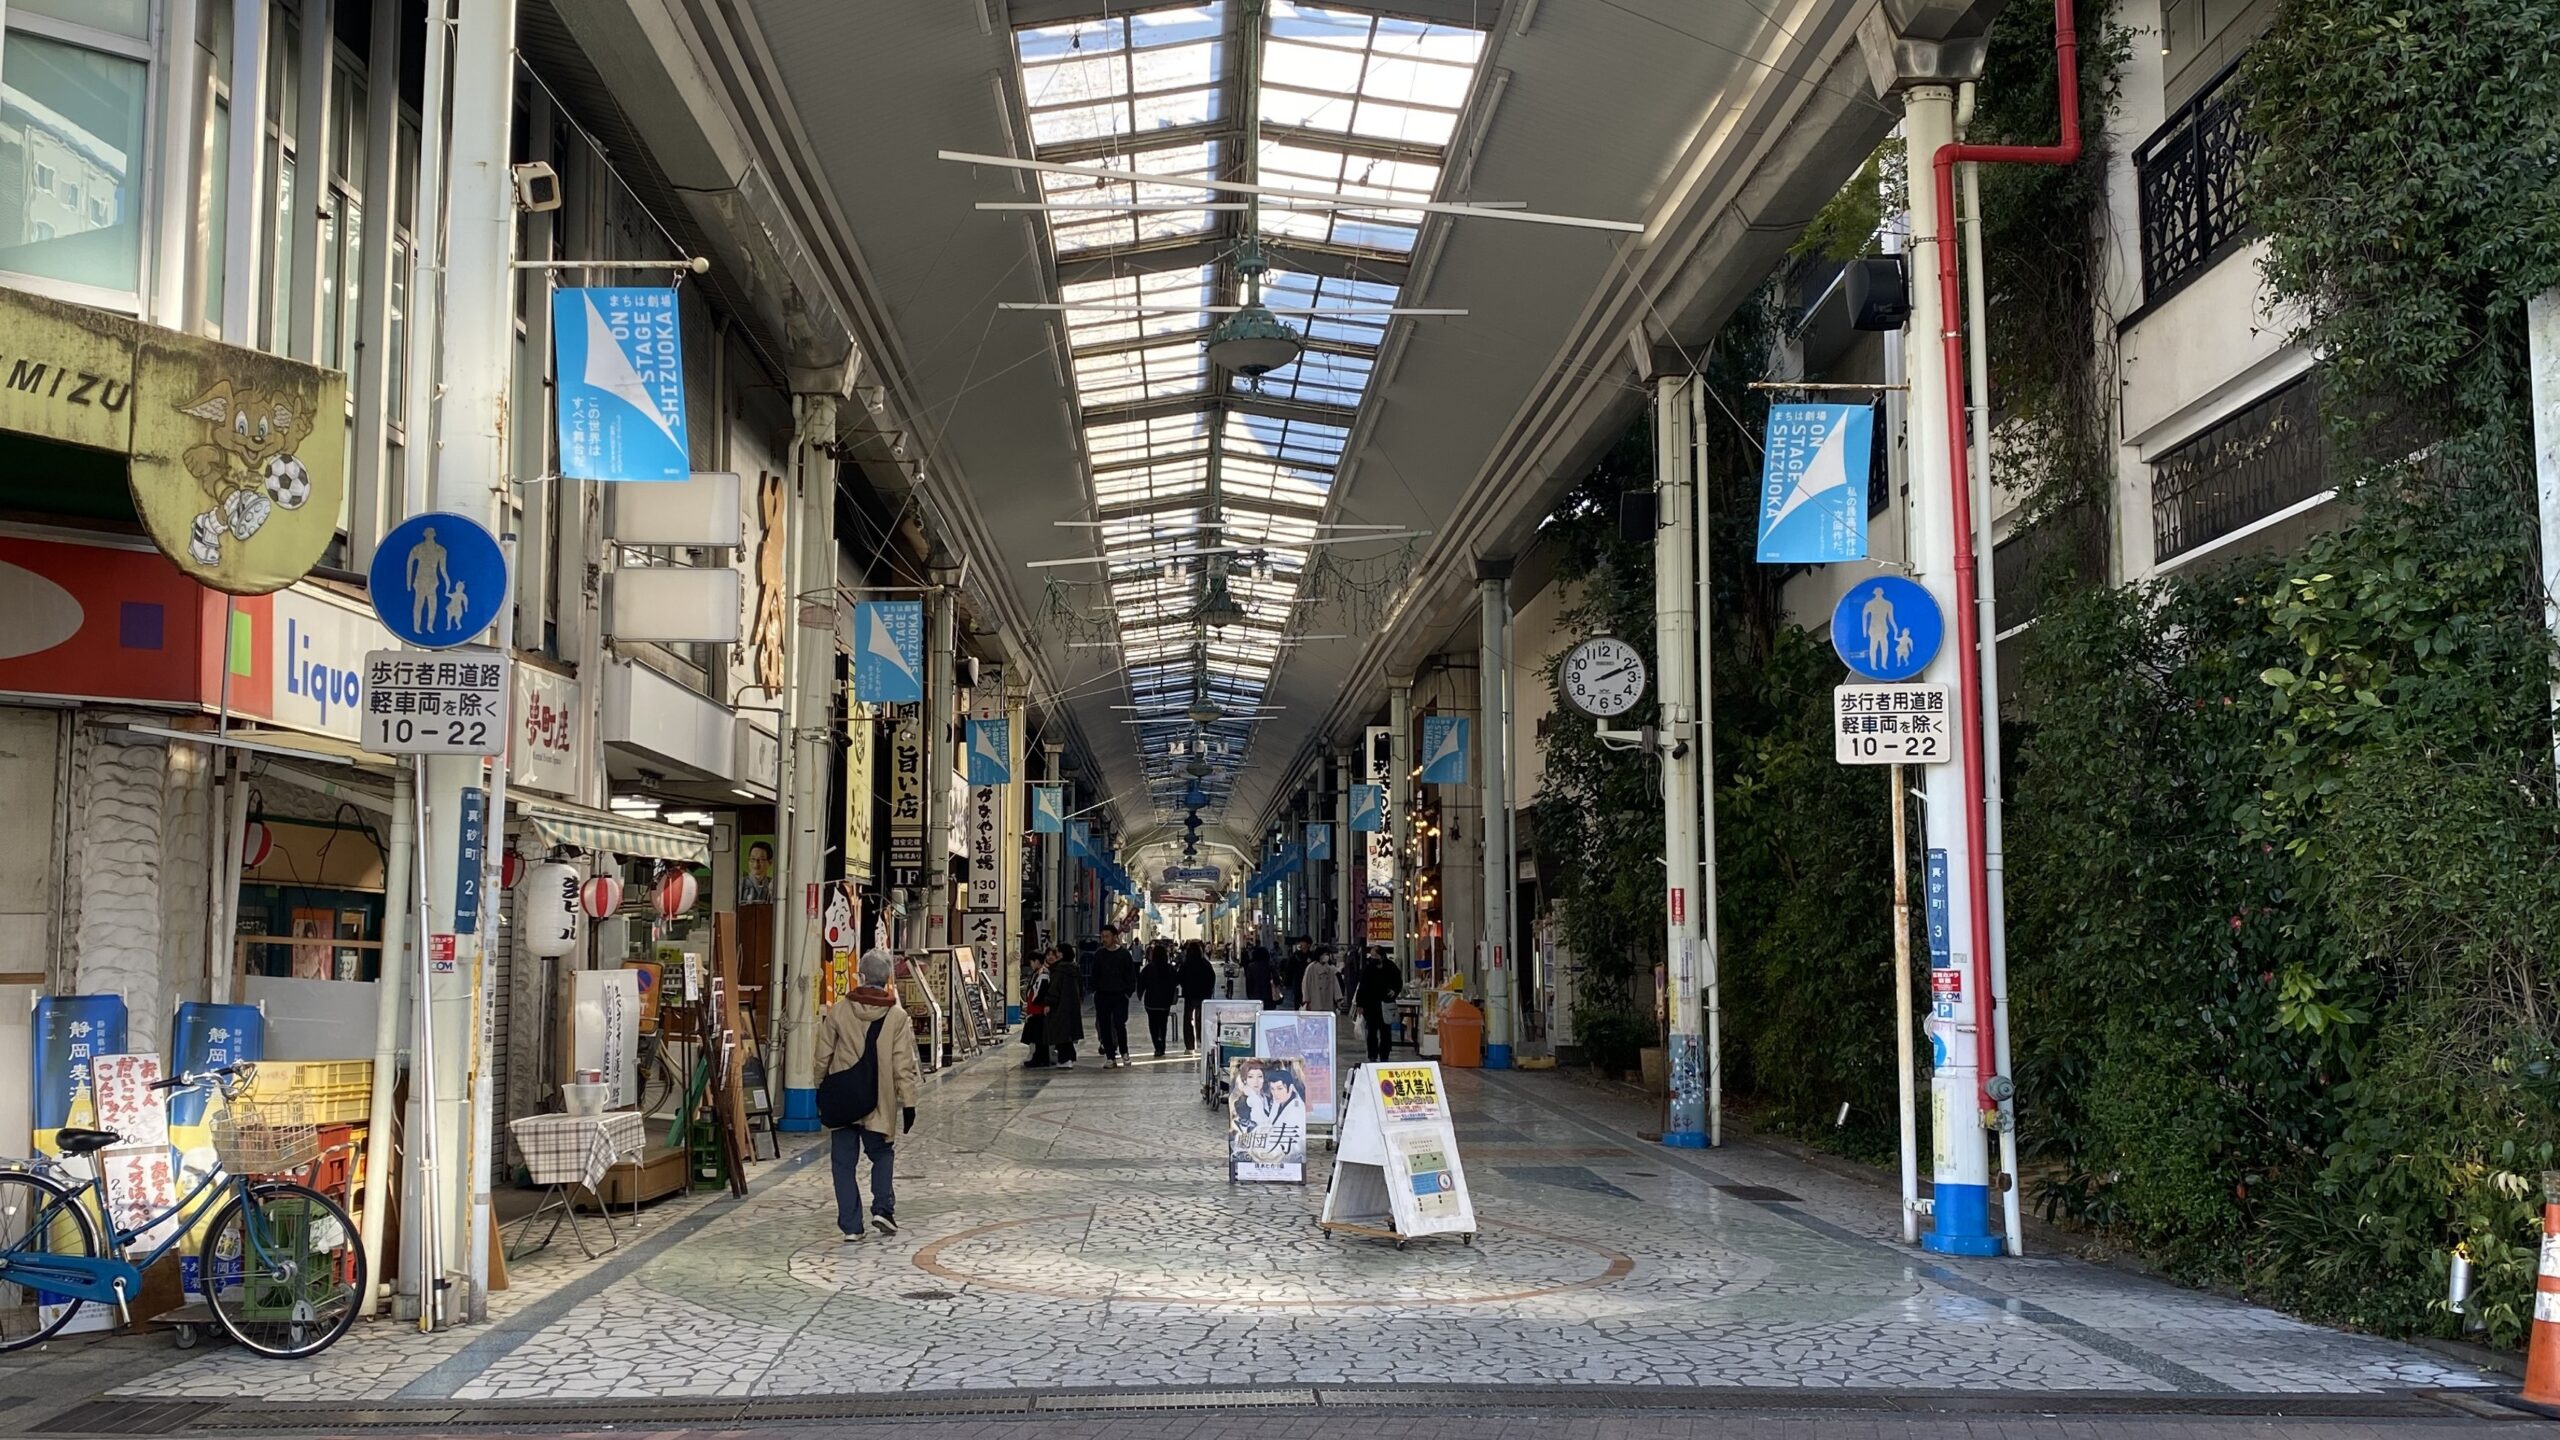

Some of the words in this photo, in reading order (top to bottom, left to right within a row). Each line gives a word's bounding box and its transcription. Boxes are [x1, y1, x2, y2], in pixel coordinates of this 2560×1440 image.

[610, 311, 629, 341] ON
[633, 311, 656, 384] STAGE
[655, 311, 681, 428] SHIZUOKA
[1, 356, 131, 412] MIZU
[1774, 410, 1828, 423] まちは劇場
[1809, 424, 1826, 449] ON
[1787, 424, 1806, 484] STAGE
[1764, 424, 1788, 520] SHIZUOKA
[883, 613, 894, 630] ON
[895, 613, 907, 651] STAGE
[908, 612, 920, 673] SHIZUOKA
[1598, 645, 1611, 657] 12
[1575, 658, 1587, 670] 10
[1586, 648, 1596, 660] 11
[1624, 657, 1633, 670] 2
[287, 618, 360, 727] Liquo
[370, 660, 501, 687] 歩行者用道路
[1571, 671, 1581, 683] 9
[1627, 671, 1637, 683] 3
[1576, 683, 1586, 696] 8
[1623, 684, 1633, 696] 4
[370, 689, 498, 717] 軽車両を除く
[1587, 694, 1597, 706] 7
[1599, 697, 1609, 709] 6
[1613, 694, 1623, 706] 5
[1840, 691, 1944, 711] 歩行者用道路
[1841, 714, 1943, 735] 軽車両を除く
[464, 809, 479, 861] 真砂町
[975, 783, 995, 872] かなや道場
[893, 867, 920, 886] 1F
[972, 880, 997, 891] 130
[464, 879, 474, 896] 2
[1931, 867, 1943, 909] 真砂町
[1933, 924, 1943, 938] 3
[1940, 1004, 1949, 1016] P
[138, 1058, 160, 1107] おでん
[1393, 1077, 1436, 1097] 進入禁止
[150, 1160, 172, 1208] おでん
